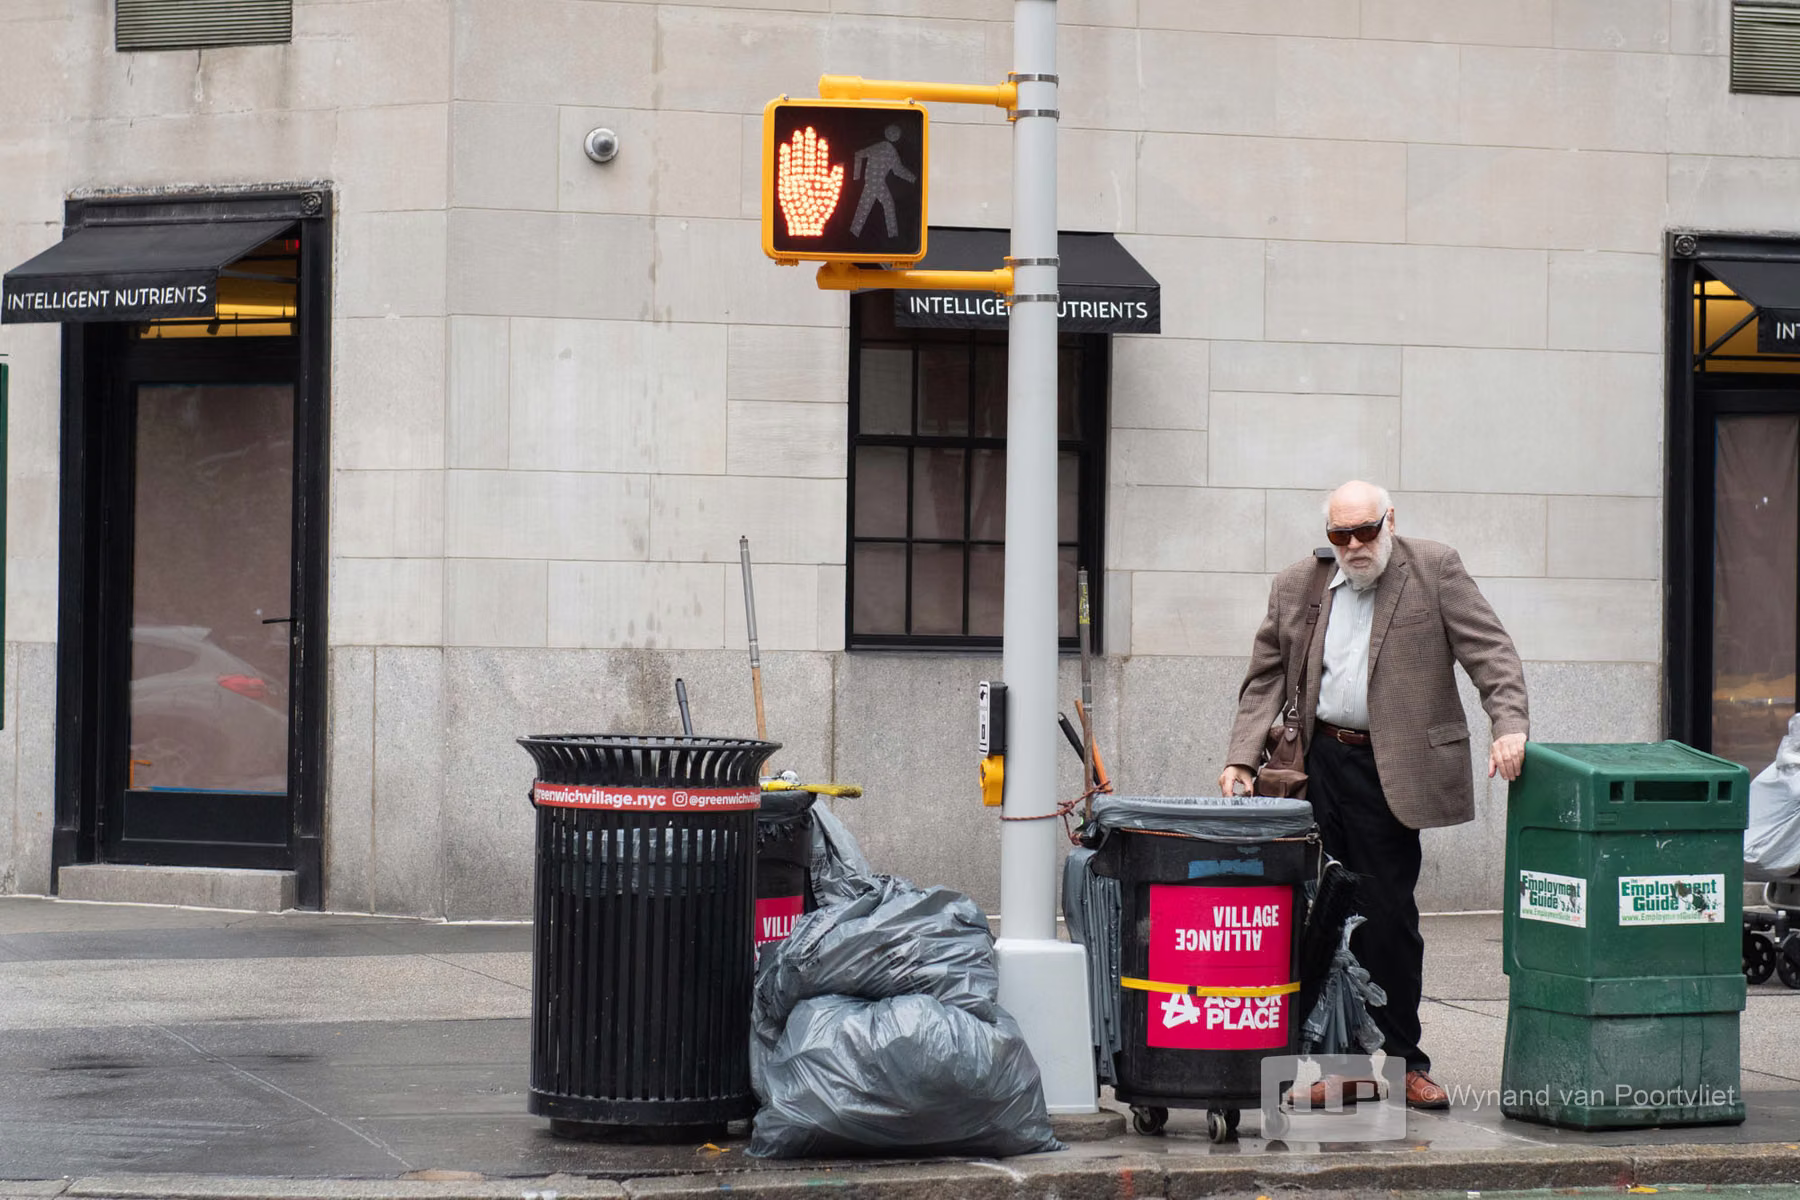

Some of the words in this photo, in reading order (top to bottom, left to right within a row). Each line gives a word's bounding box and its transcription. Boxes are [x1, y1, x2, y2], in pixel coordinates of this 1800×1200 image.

[8, 290, 110, 310] INTELLIGENT
[115, 286, 207, 307] NUTRIENTS
[910, 296, 1010, 316] INTELLIGE
[1057, 300, 1148, 319] UTRIENTS
[1530, 892, 1558, 909] Guide
[1633, 896, 1679, 911] Guide
[1213, 905, 1279, 928] VILLAGE
[1175, 929, 1262, 952] ALLIANCE
[1206, 1007, 1280, 1030] PLACE
